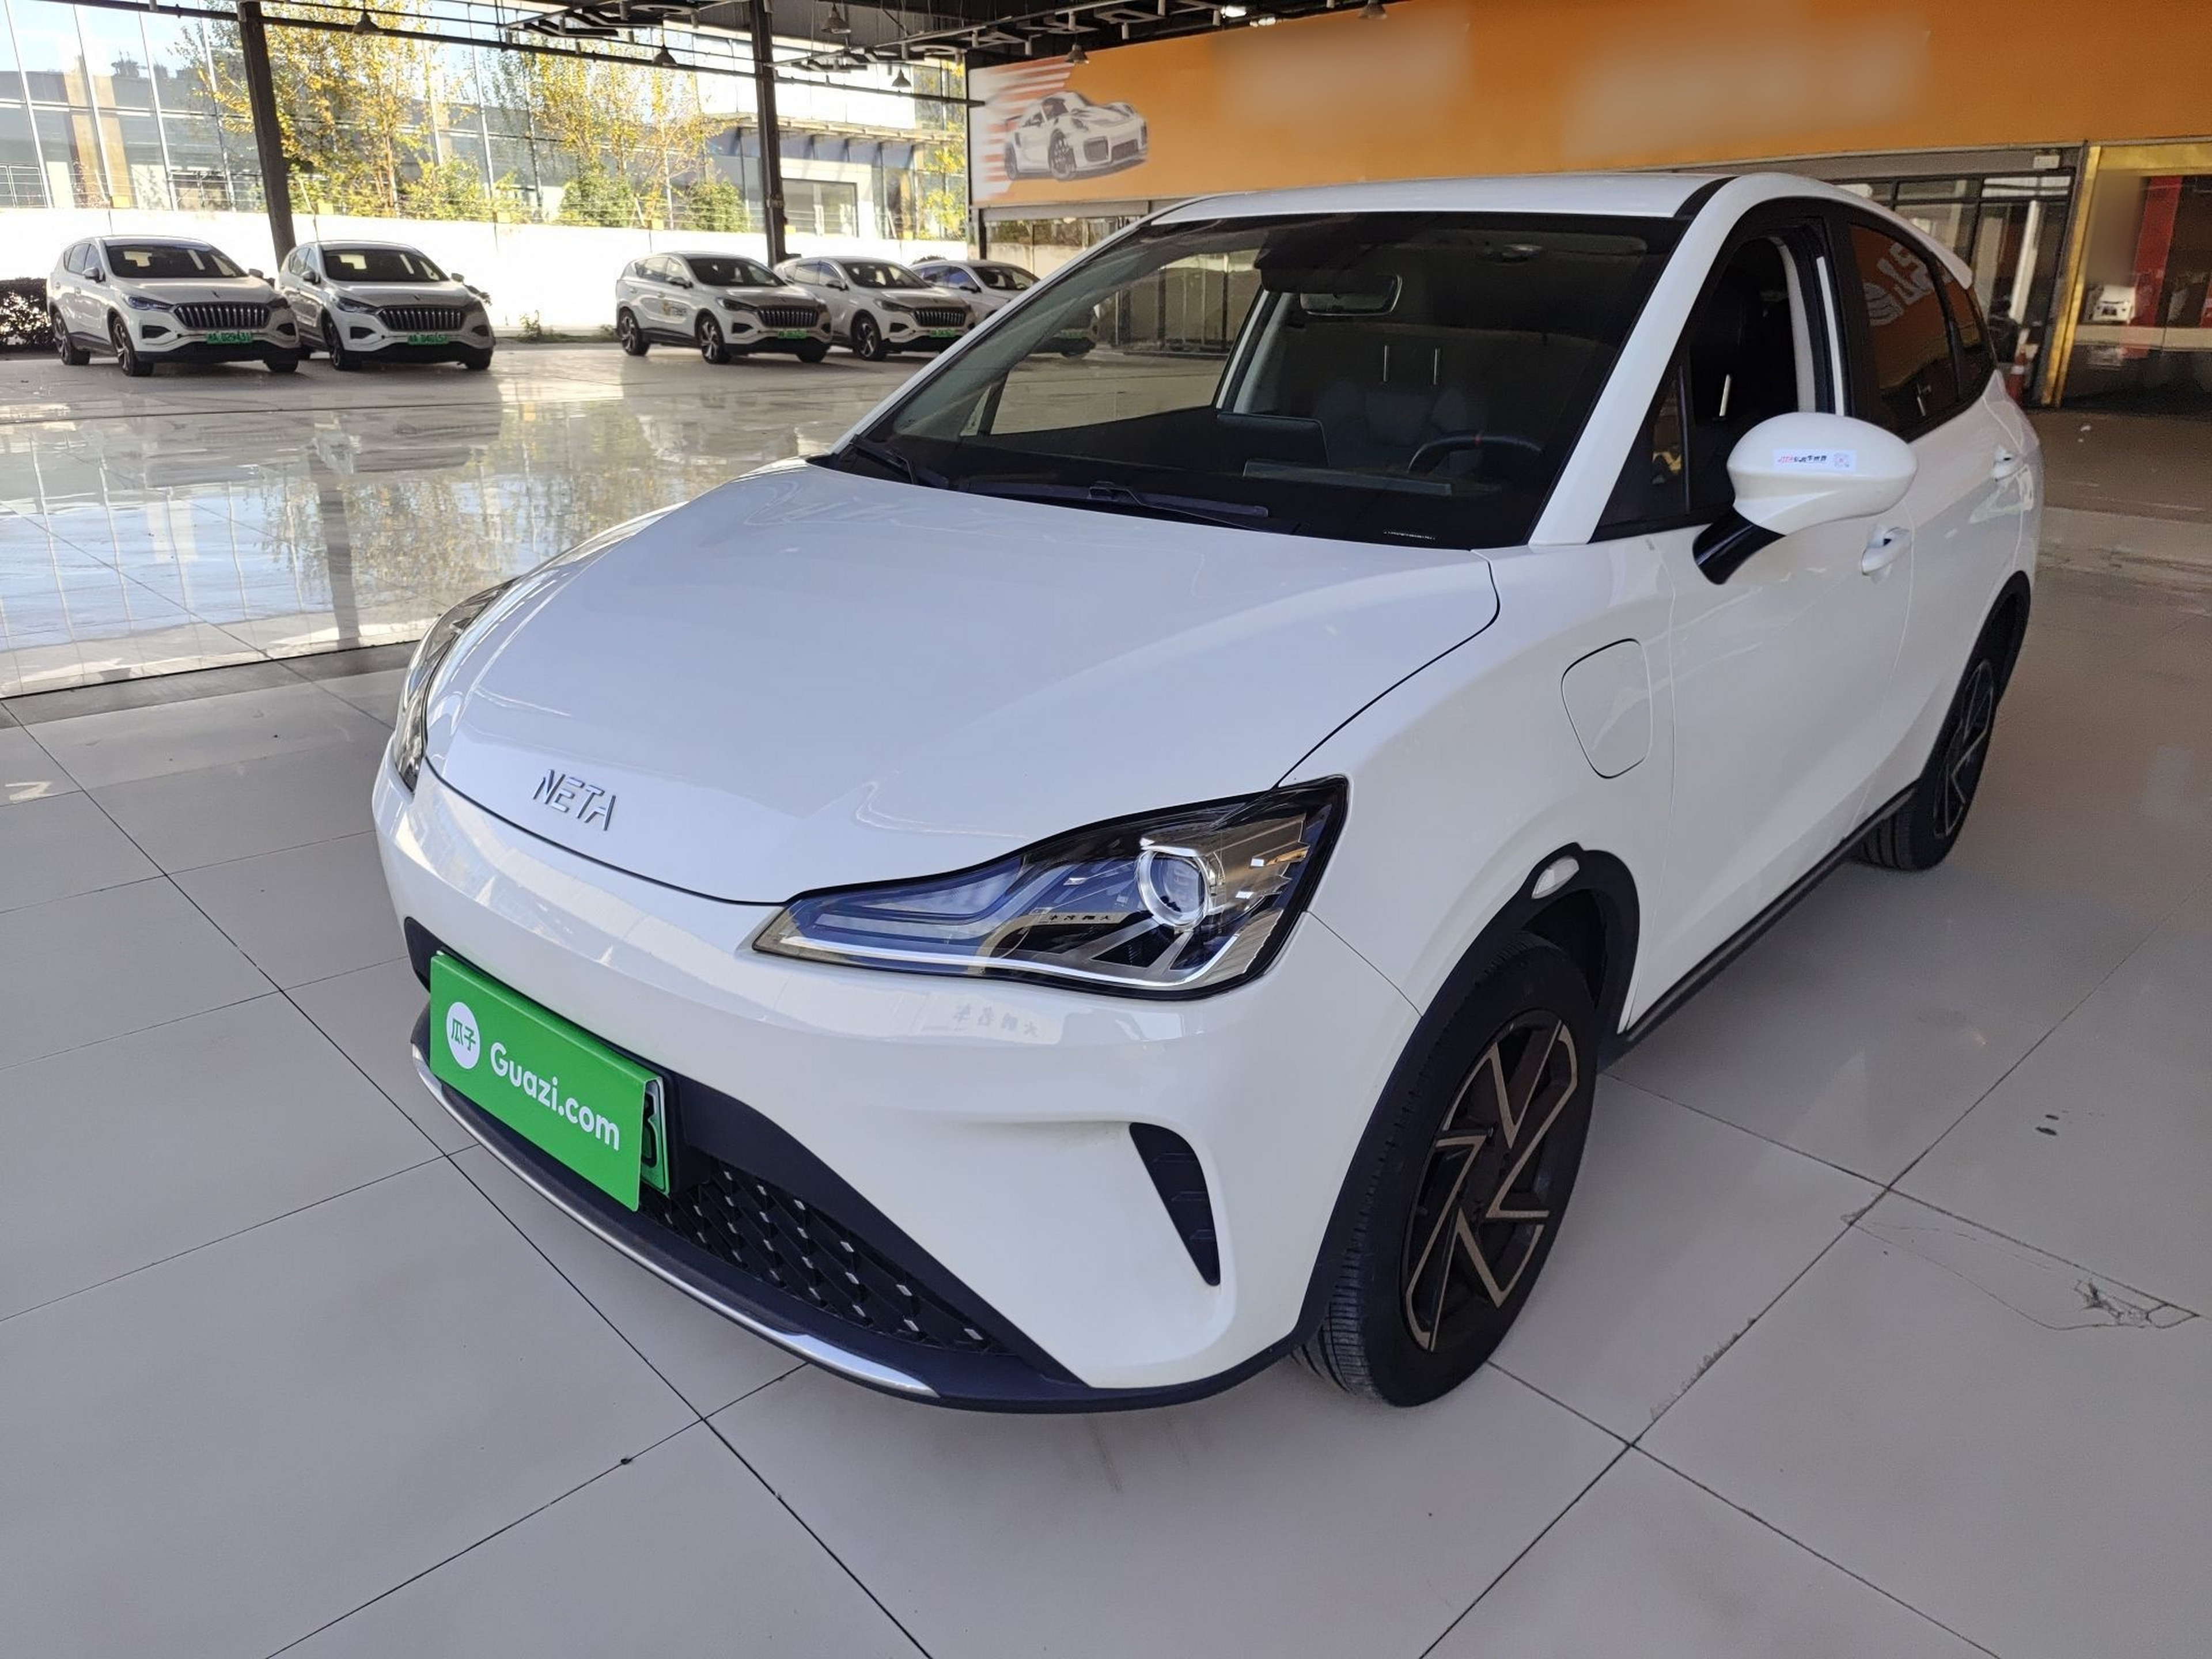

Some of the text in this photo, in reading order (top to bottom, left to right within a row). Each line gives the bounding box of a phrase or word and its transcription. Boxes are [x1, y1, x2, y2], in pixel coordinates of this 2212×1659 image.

[533, 768, 616, 831] NETA
[451, 1018, 476, 1051] 瓜子
[490, 1042, 620, 1151] Guazi.com
